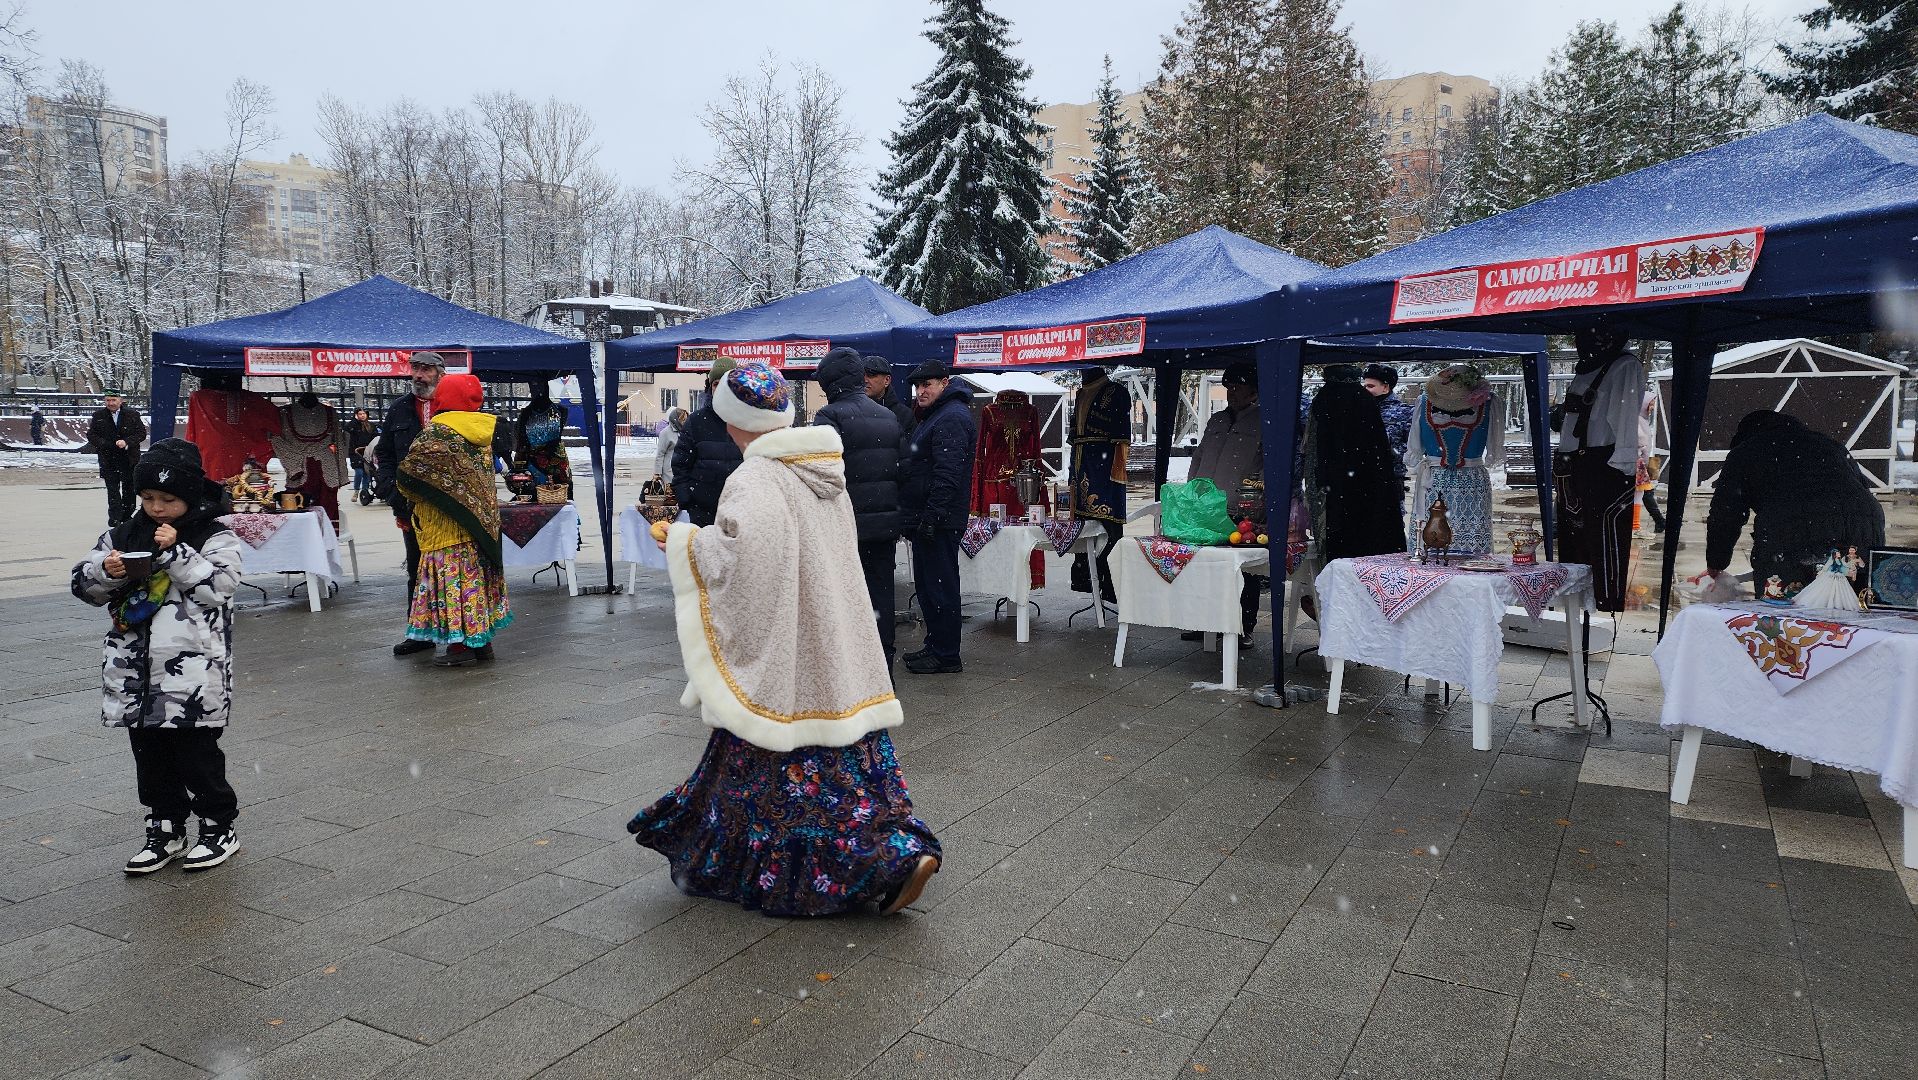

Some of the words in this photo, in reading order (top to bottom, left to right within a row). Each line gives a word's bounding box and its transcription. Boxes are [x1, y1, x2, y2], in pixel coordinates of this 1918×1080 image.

[1485, 253, 1629, 289] САМОВАРНАЯ
[1504, 280, 1599, 306] станция
[1006, 328, 1082, 348] САМОВАРНАЯ
[316, 351, 398, 363] САМОВАРНА
[721, 344, 783, 356] САМОВАРНАЯ
[1017, 344, 1068, 361] станция
[333, 363, 393, 375] станция
